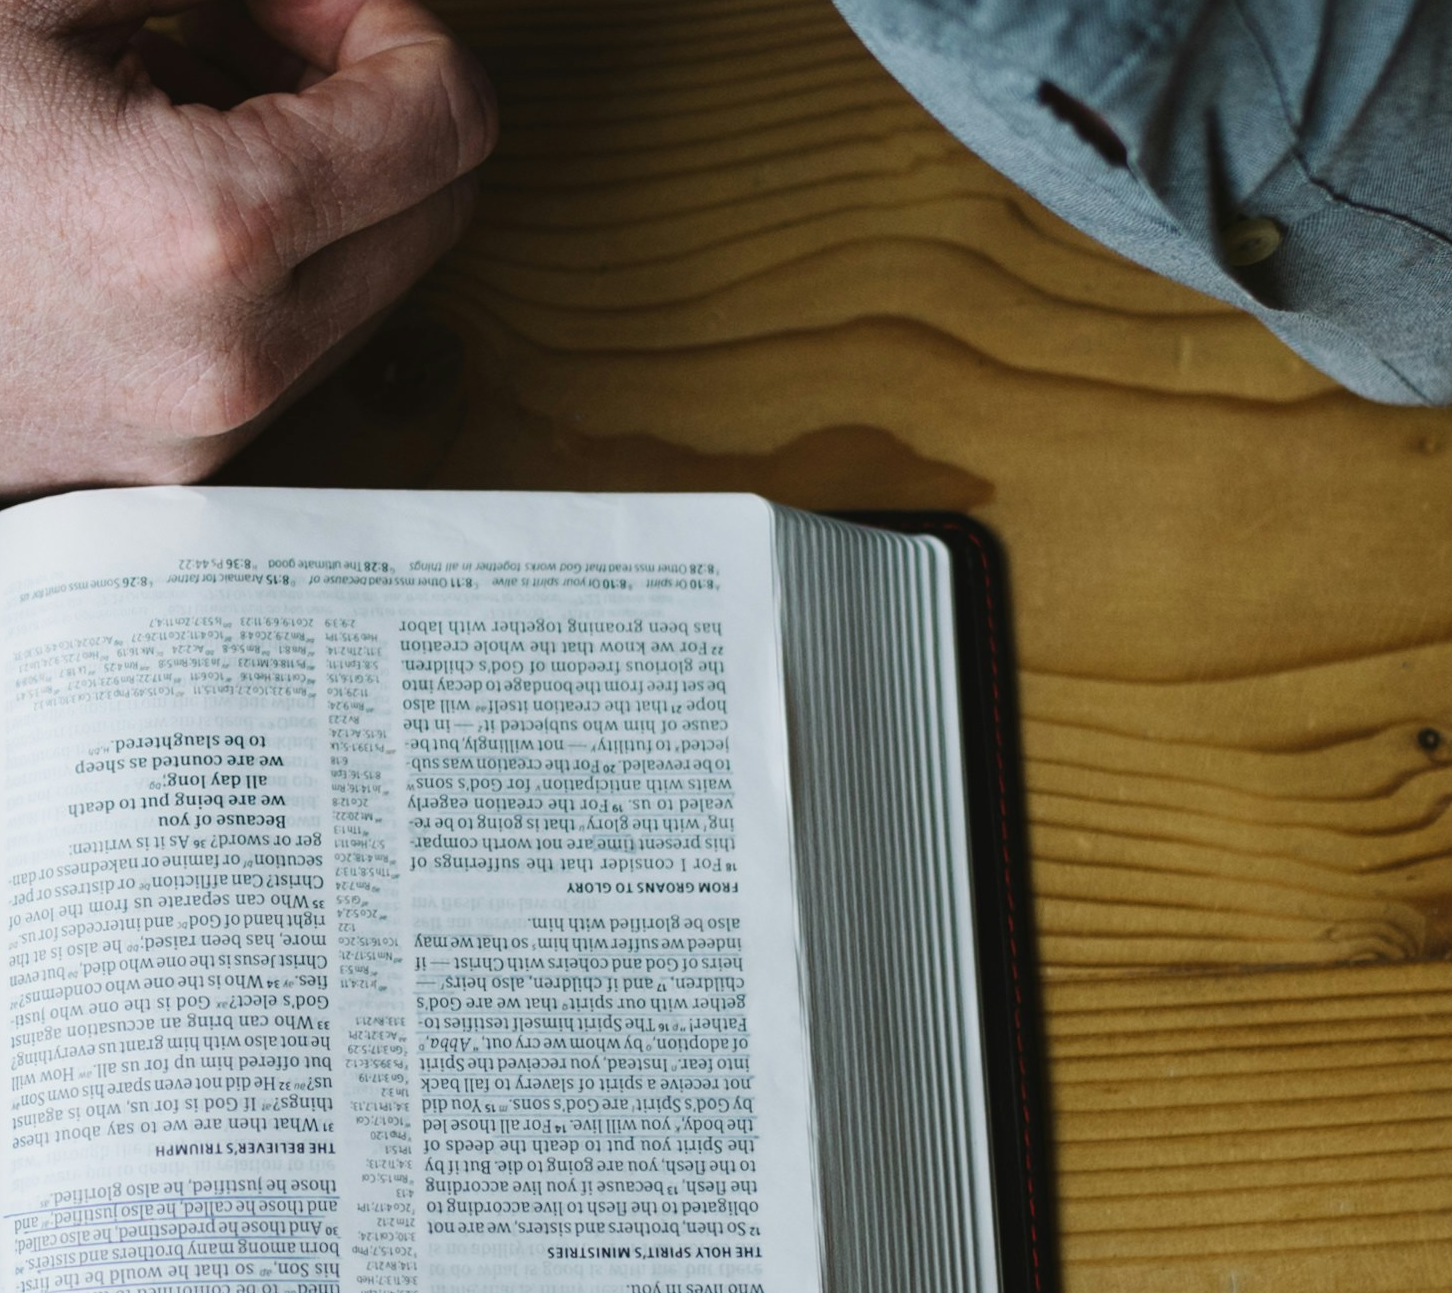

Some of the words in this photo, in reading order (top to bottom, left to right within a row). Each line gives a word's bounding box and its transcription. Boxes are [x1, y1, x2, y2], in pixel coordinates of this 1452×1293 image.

[268, 558, 296, 569] good
[297, 560, 342, 571] ultimate
[166, 573, 200, 584] father
[202, 574, 217, 584] for
[218, 573, 264, 585] Aramaic
[399, 621, 443, 636] labor
[448, 621, 487, 636] with
[491, 617, 563, 636] together
[567, 618, 644, 637] groaning
[649, 622, 689, 637] been
[694, 622, 722, 637] has
[75, 759, 125, 774] sheep
[129, 757, 148, 769] as
[152, 755, 223, 771] counted
[227, 755, 255, 767] are
[259, 755, 285, 767] we
[119, 798, 137, 811] to
[141, 795, 170, 810] put
[175, 794, 225, 810] being
[228, 794, 257, 806] are
[261, 795, 287, 807] we
[69, 800, 116, 818] death
[158, 812, 191, 827] you
[194, 815, 213, 830] of
[216, 814, 286, 830] Because
[567, 882, 612, 895] GLORY
[615, 882, 634, 894] TO
[637, 882, 695, 894] GROANS
[699, 882, 739, 894] FROM
[527, 917, 565, 933] him.
[568, 917, 607, 933] with
[609, 914, 681, 934] glorified
[684, 918, 705, 933] be
[707, 917, 741, 933] also
[156, 1143, 223, 1158] TRIUMPH
[226, 1142, 306, 1156] BELIEVER'S
[309, 1142, 336, 1155] THE
[547, 1247, 631, 1260] MINISTRIES
[634, 1247, 692, 1260] SPIRIT'S
[695, 1246, 732, 1259] HOLY
[735, 1247, 763, 1258] THE
